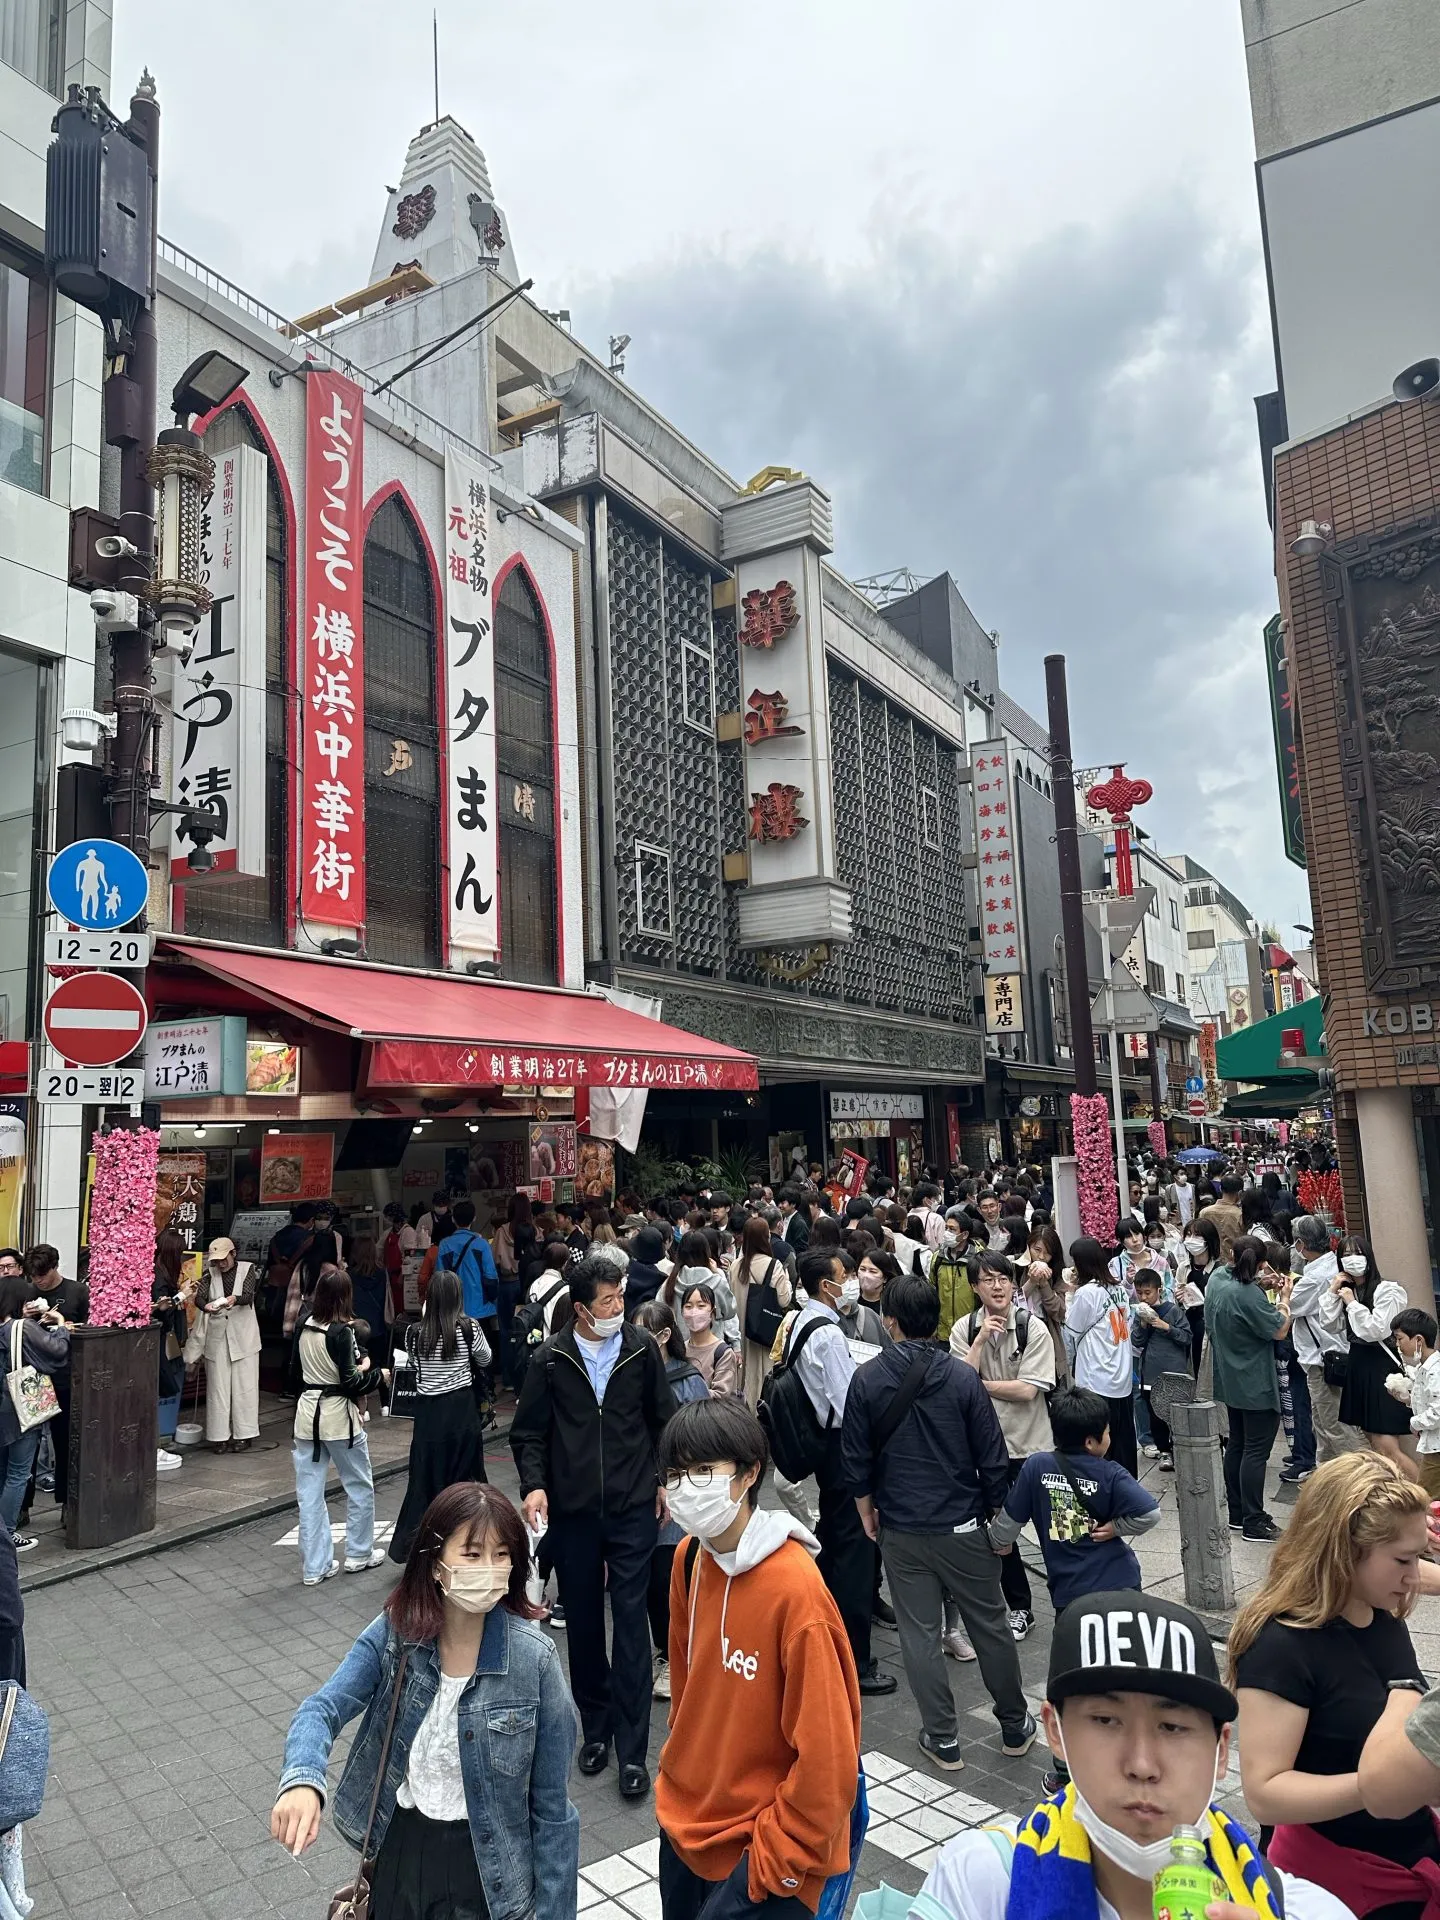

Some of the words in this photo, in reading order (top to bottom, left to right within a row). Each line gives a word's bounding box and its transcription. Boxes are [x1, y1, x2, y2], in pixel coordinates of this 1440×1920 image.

[222, 459, 235, 569] 創業明治二十七年
[448, 506, 469, 585] 元祖
[468, 479, 489, 597] 横浜名物
[450, 617, 492, 915] ブタまん
[1362, 1004, 1440, 1036] KOB
[162, 1043, 205, 1058] ブタまんの
[490, 1053, 588, 1080] 創業明治27年
[603, 1057, 709, 1086] ブタまんの江戸清
[48, 1076, 135, 1098] 20-翌12
[156, 1060, 209, 1088] 江戸清
[723, 1637, 758, 1680] Lee
